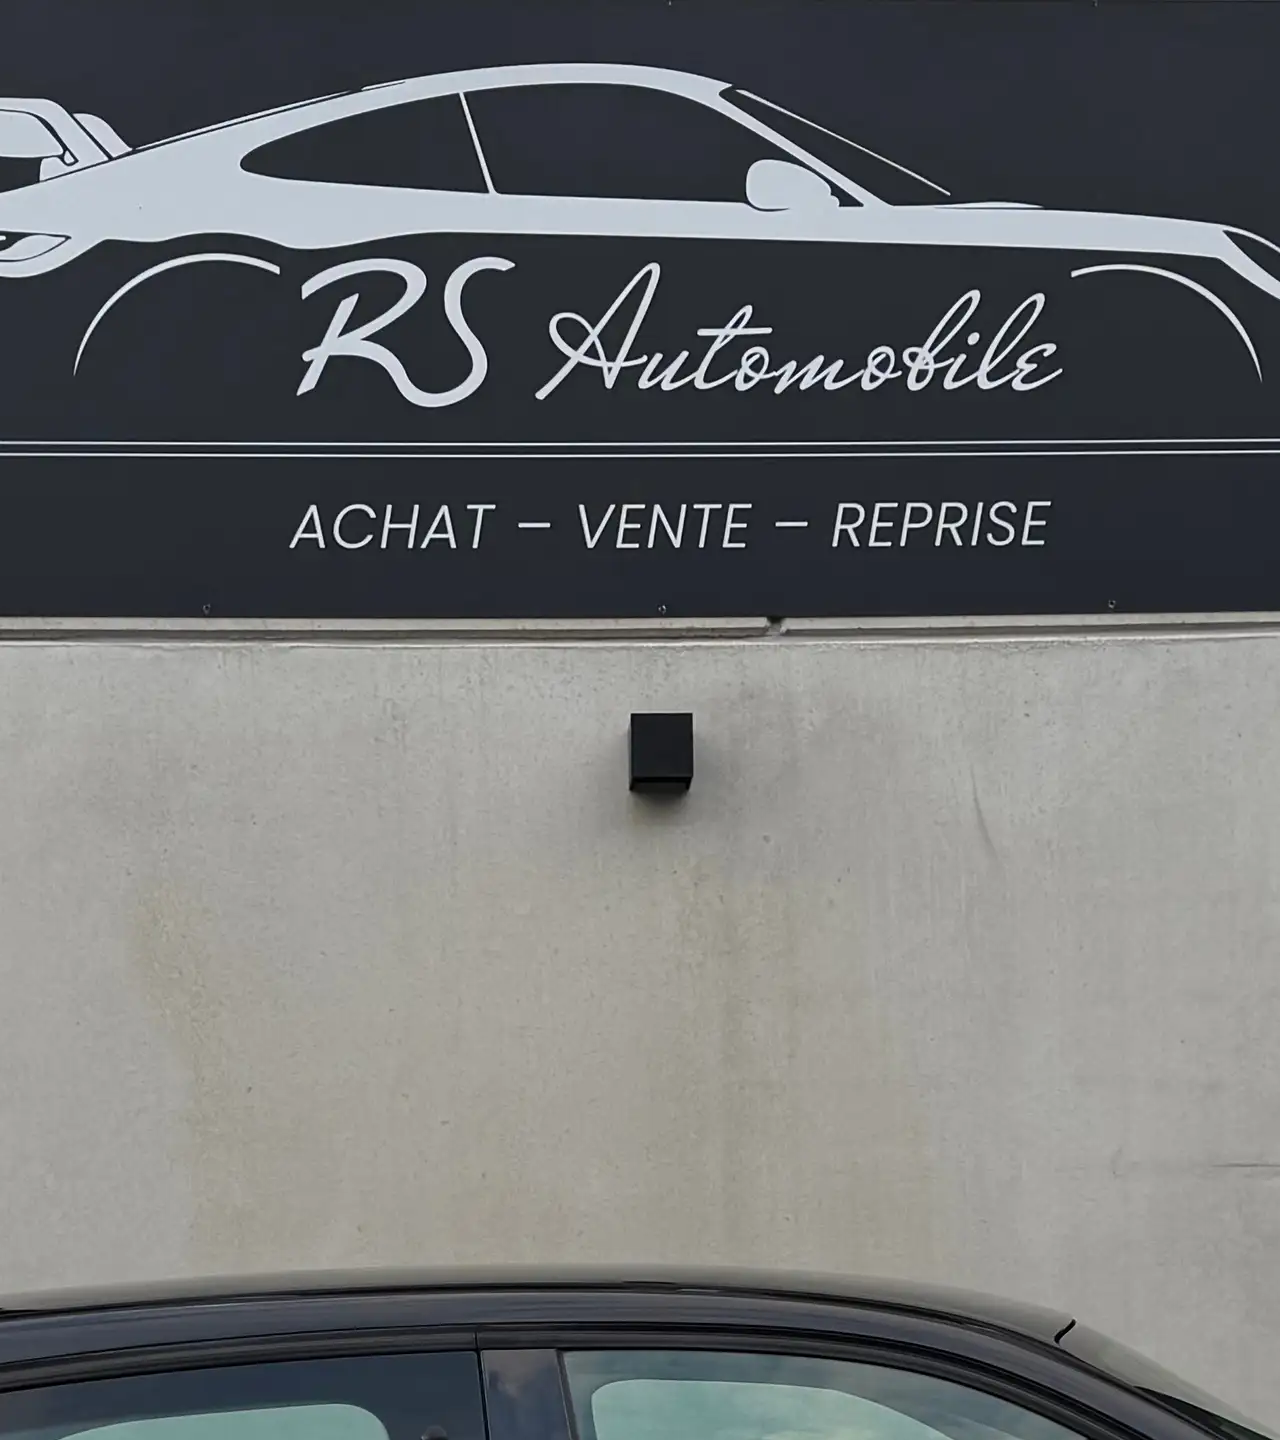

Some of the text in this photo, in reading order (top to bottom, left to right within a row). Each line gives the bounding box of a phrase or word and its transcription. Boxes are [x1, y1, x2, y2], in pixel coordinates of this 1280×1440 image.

[297, 257, 1063, 408] RS Automobile
[288, 503, 497, 549] ACHAT
[578, 503, 753, 549] VENTE
[831, 500, 1052, 548] REPRISE
